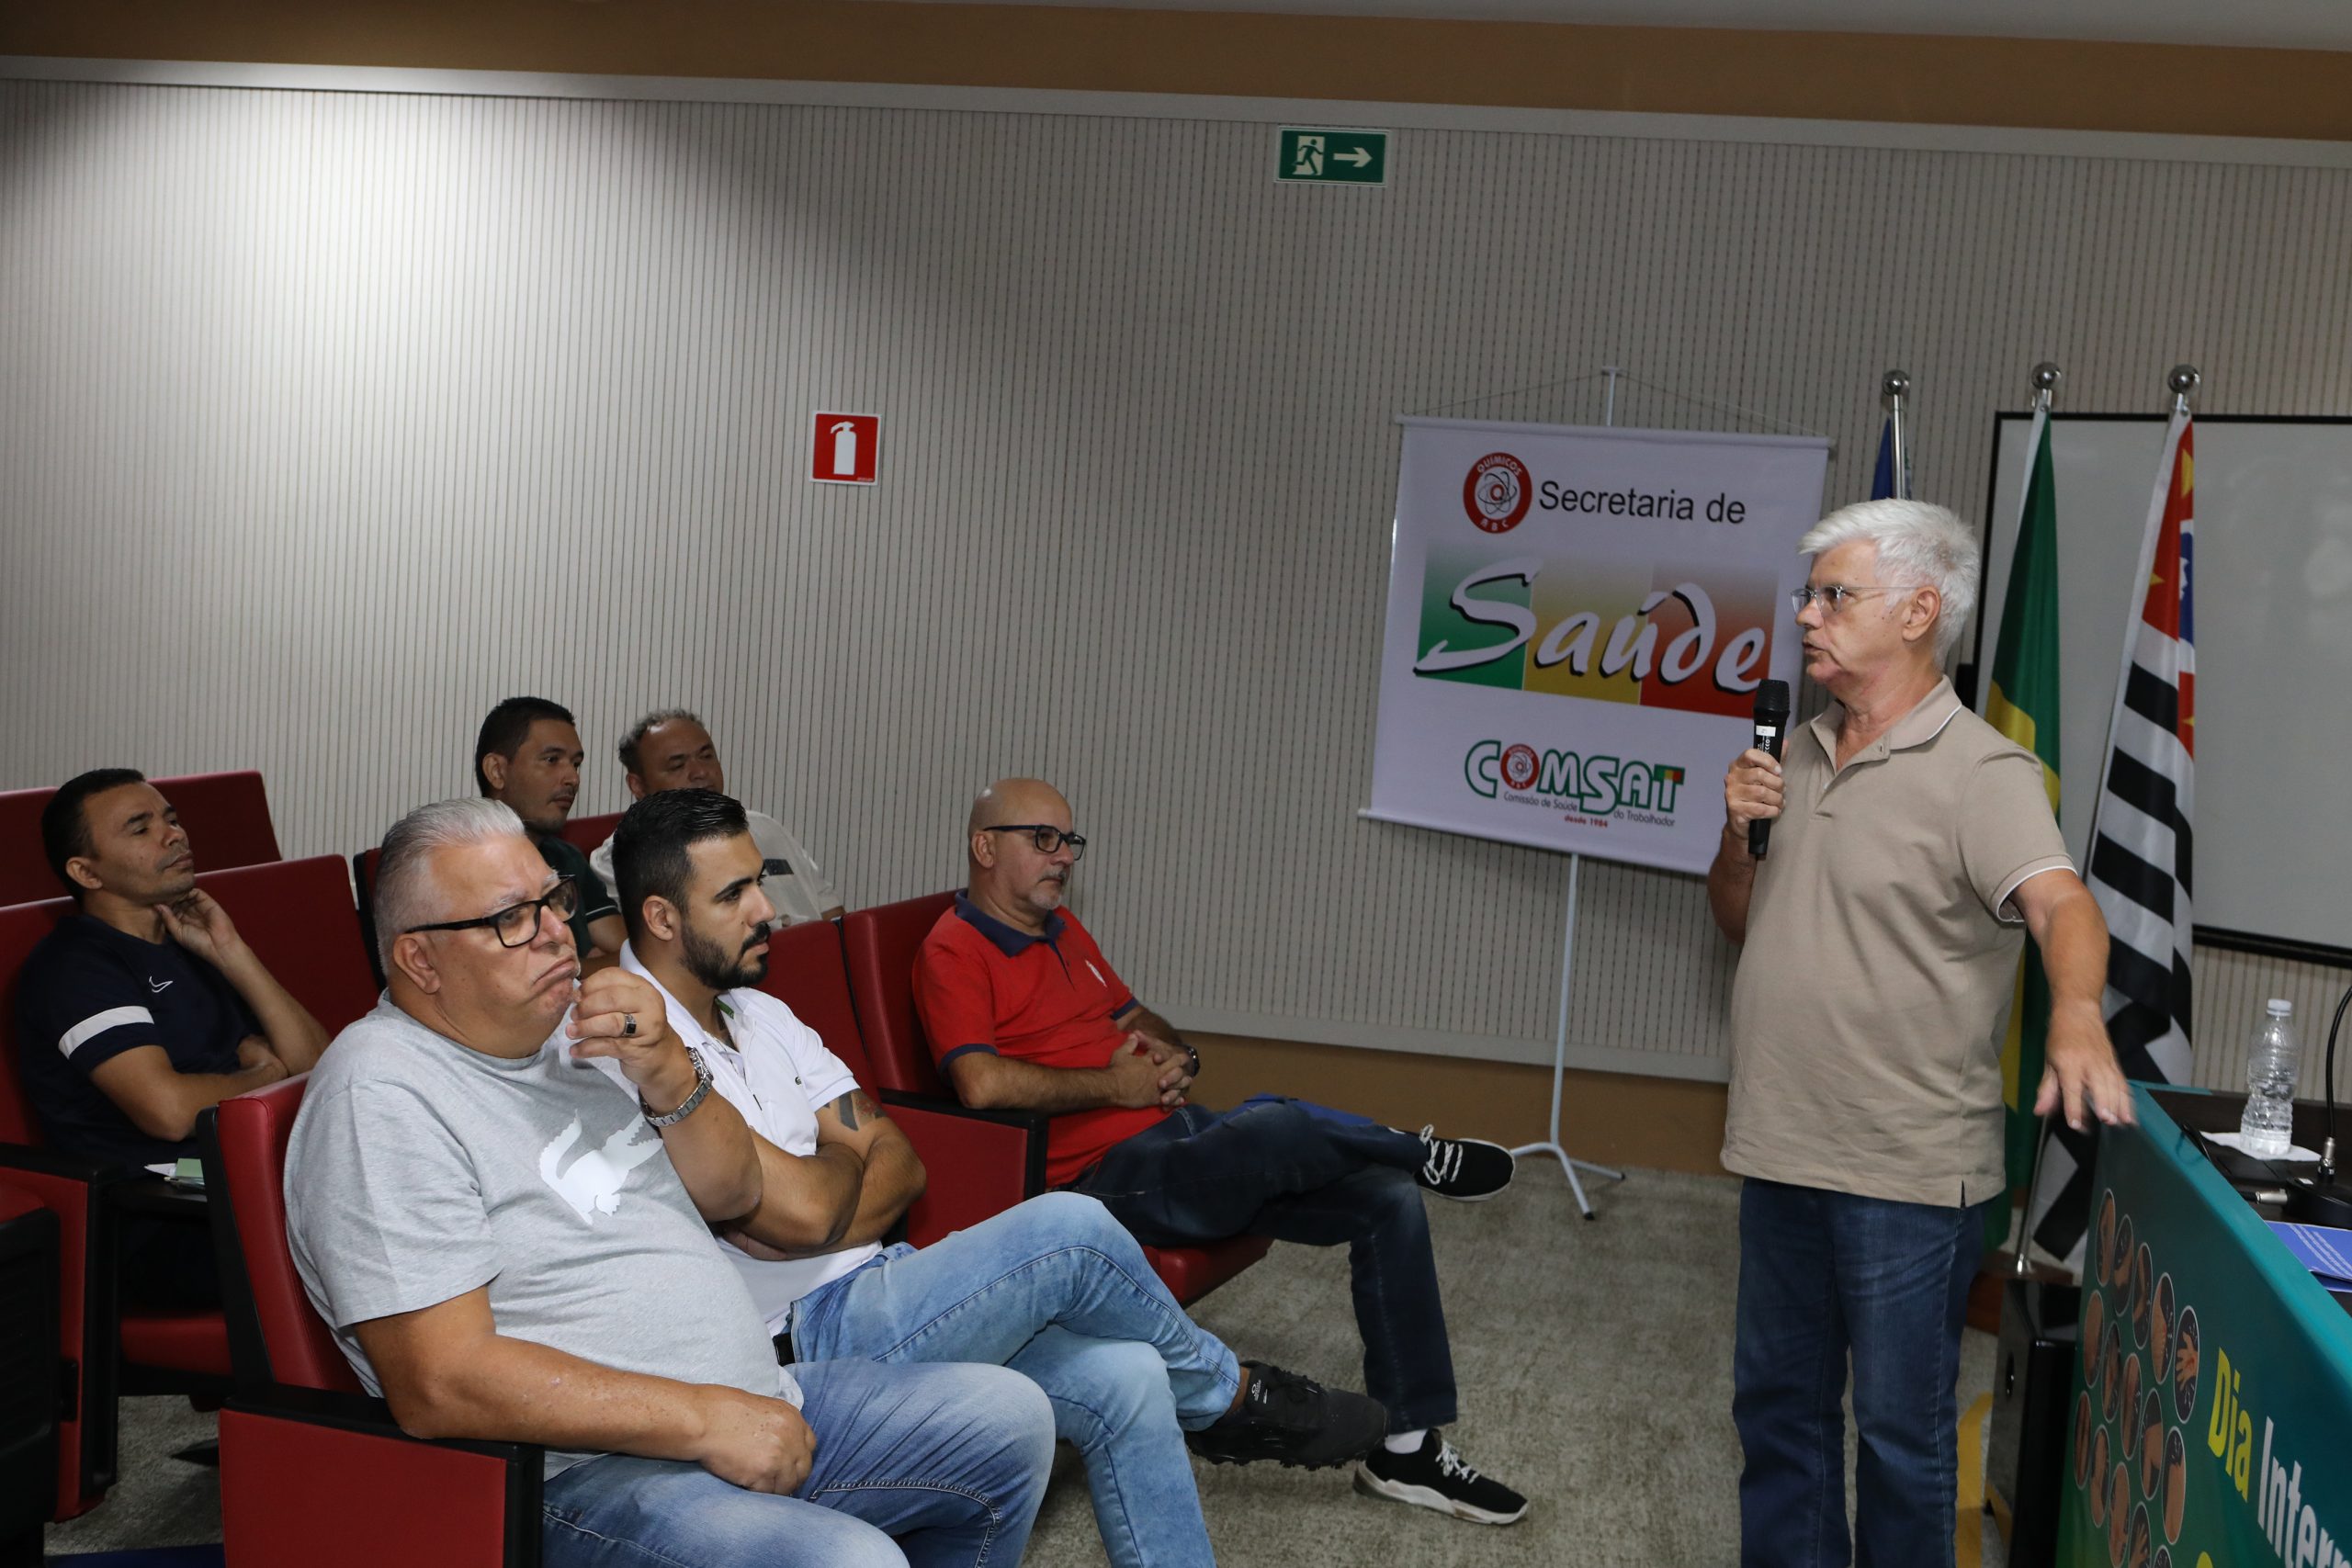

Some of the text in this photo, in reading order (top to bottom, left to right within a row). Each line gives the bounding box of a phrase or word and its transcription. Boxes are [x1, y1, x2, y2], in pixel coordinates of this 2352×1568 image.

[1539, 480, 1747, 524] Secretaria de
[1412, 558, 1764, 694] Saúde
[1464, 739, 1685, 816] COMSAT
[1541, 797, 1551, 808] de
[1553, 798, 1577, 812] Saúde
[1614, 809, 1624, 819] do
[1627, 809, 1676, 827] Trabalhador
[1564, 815, 1587, 825] desde
[2207, 1347, 2351, 1568] Dia Inter
